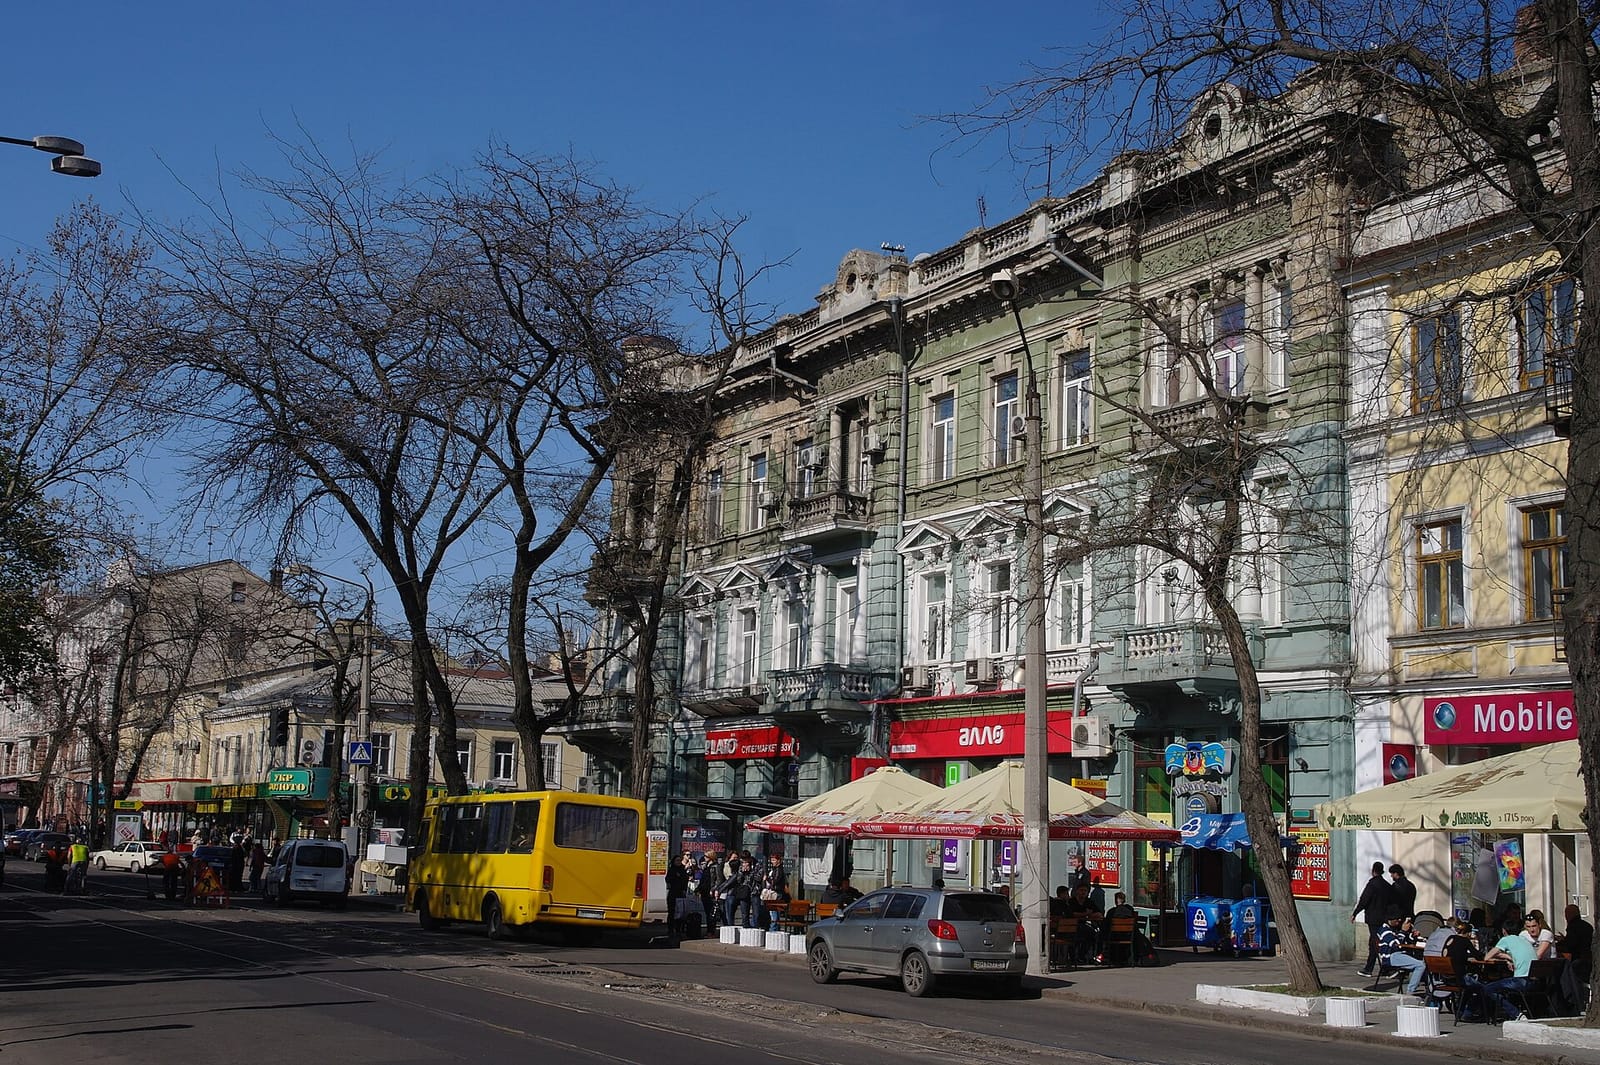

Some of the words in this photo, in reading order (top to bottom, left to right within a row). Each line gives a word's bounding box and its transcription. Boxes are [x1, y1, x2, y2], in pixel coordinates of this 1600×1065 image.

[1474, 701, 1573, 732] Mobile
[1381, 814, 1393, 823] 1715
[1394, 816, 1406, 825] року
[1504, 813, 1519, 822] 1715
[1520, 815, 1535, 824] року
[1310, 845, 1327, 854] 2370
[1310, 857, 1327, 867] 2550
[1314, 871, 1327, 881] 450
